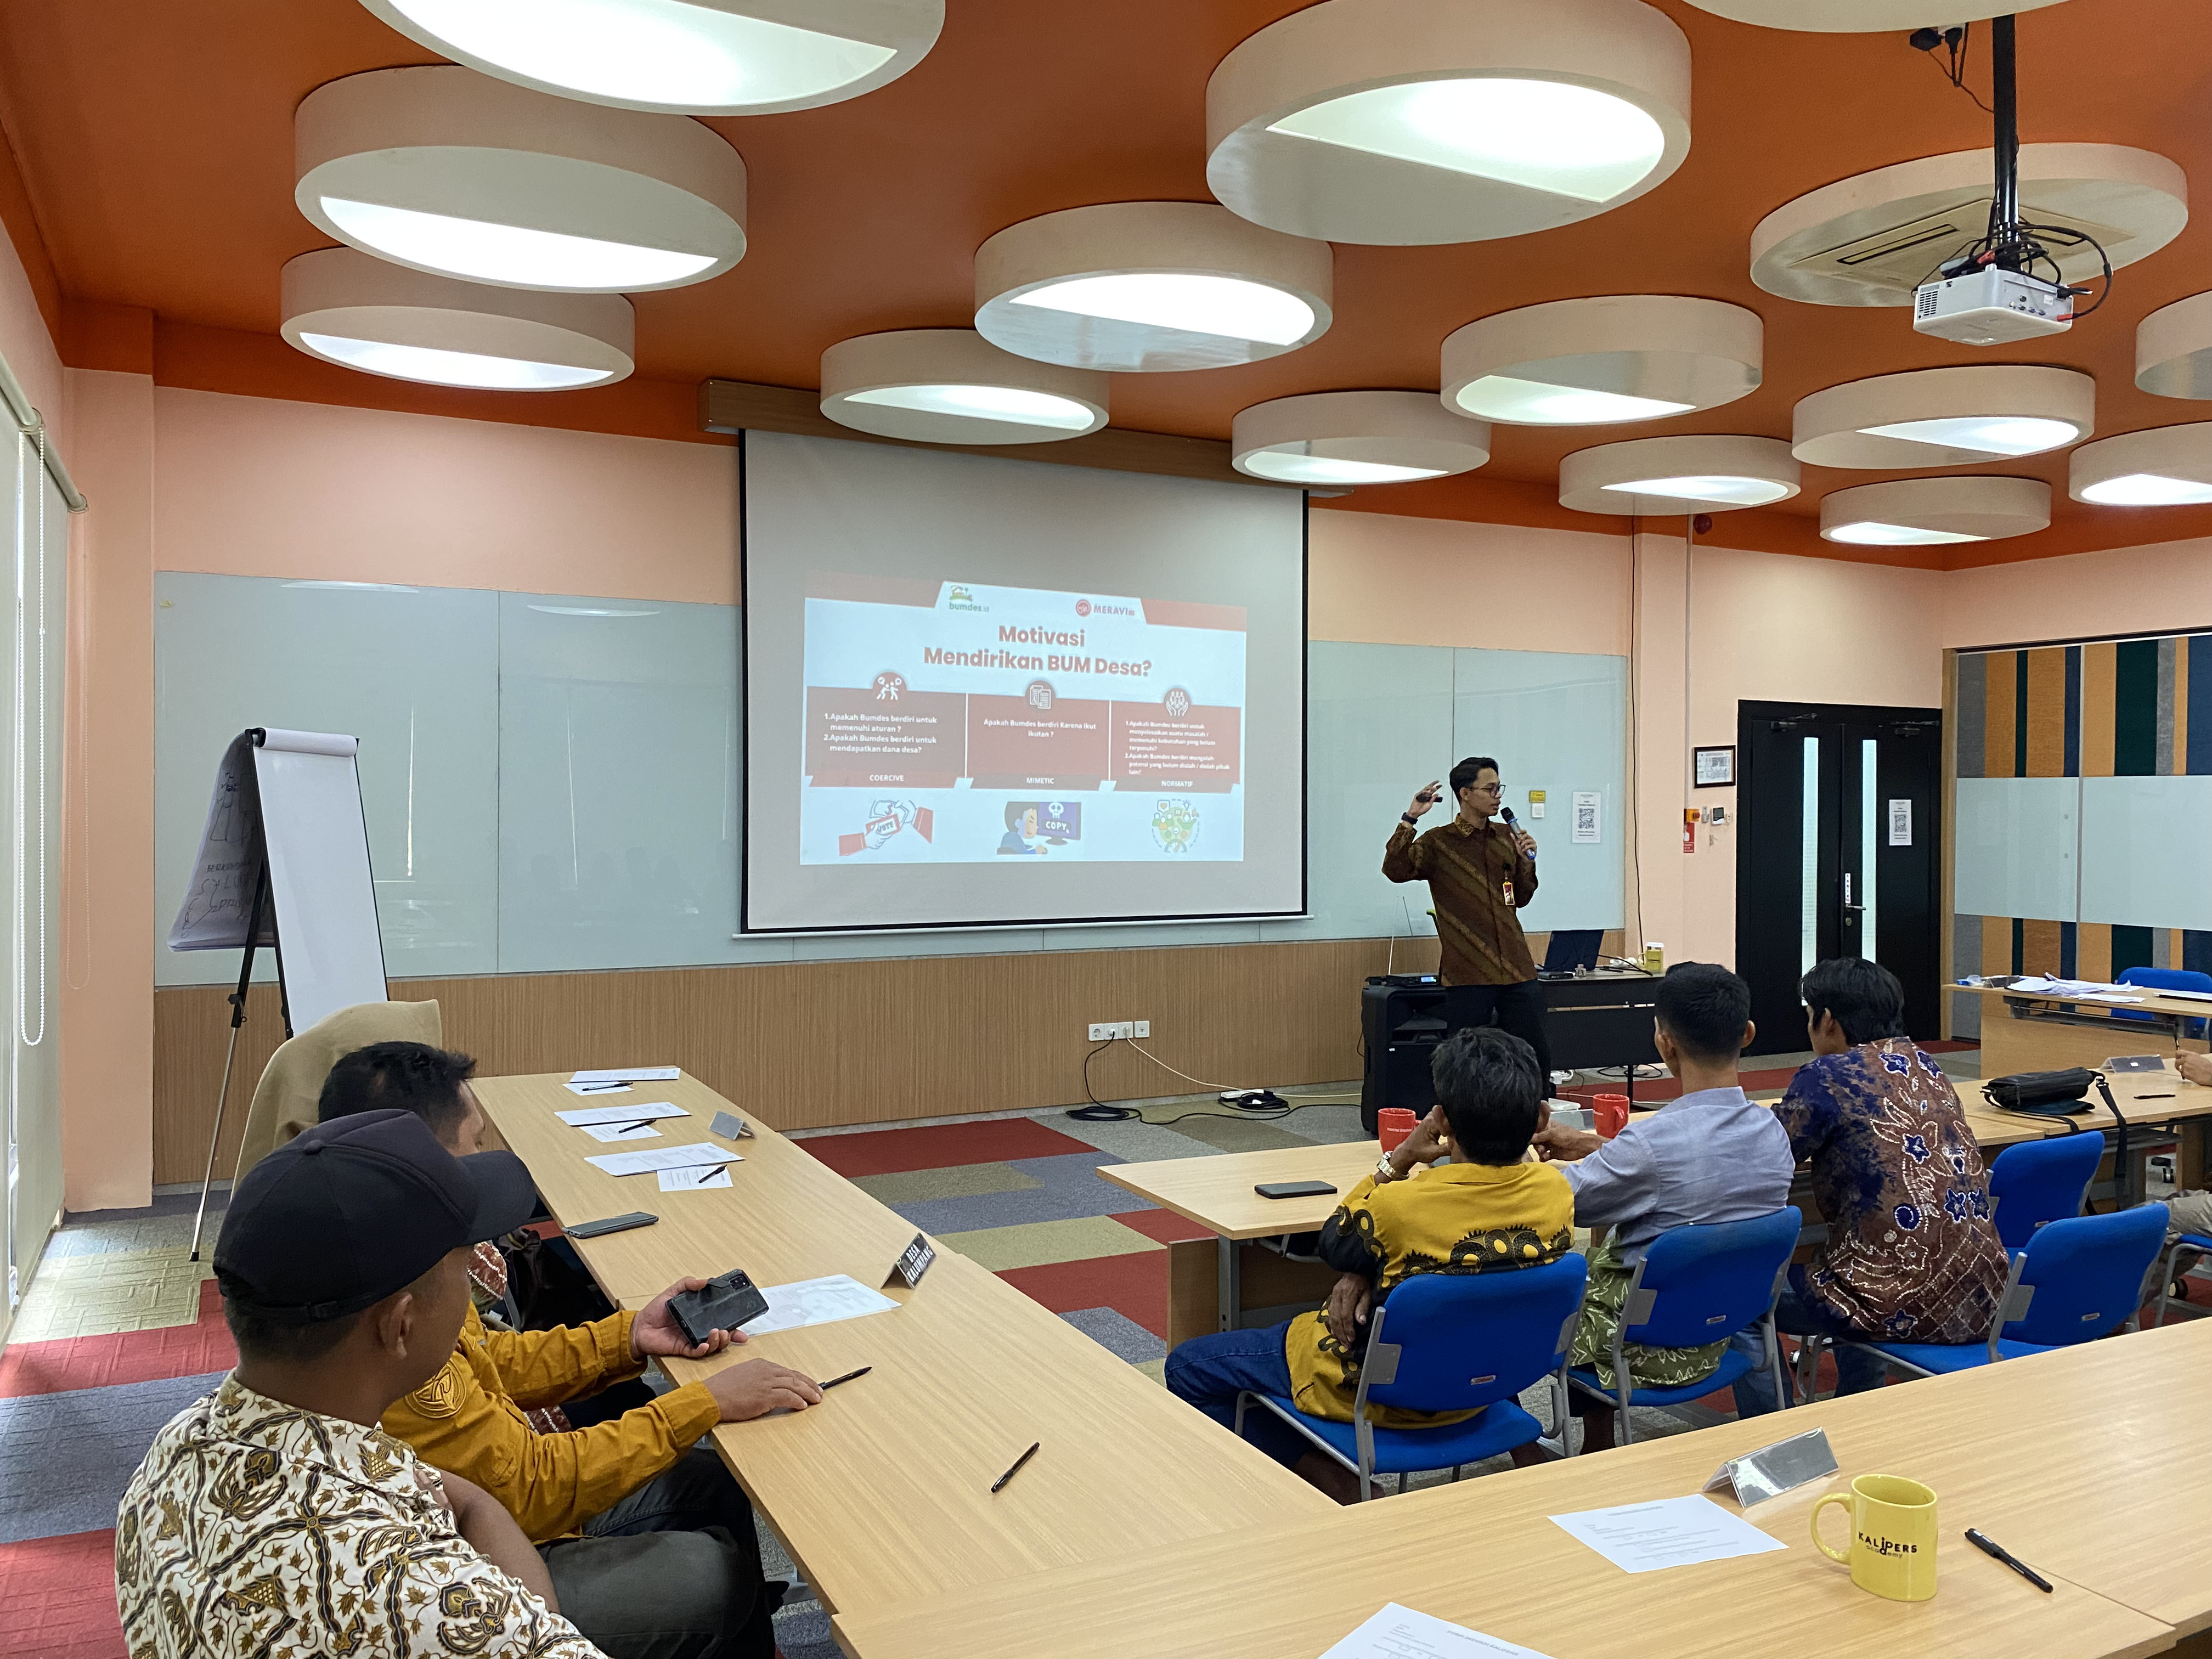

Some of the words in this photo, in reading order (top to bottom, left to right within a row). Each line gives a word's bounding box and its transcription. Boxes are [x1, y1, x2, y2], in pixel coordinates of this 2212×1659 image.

[998, 625, 1085, 647] Motivasi
[924, 646, 1043, 670] Mendirikan
[1047, 654, 1091, 673] BUM
[1094, 657, 1152, 677] Desa?
[860, 714, 889, 722] Bumdes
[890, 714, 915, 723] berdiri
[916, 715, 937, 724] untuk
[983, 719, 1009, 727] Apakah
[890, 735, 915, 743] berdiri
[830, 744, 881, 753] mendapatkan
[1046, 821, 1067, 831] COPY
[906, 1244, 921, 1263] DESA
[906, 1245, 933, 1283] KALUMPANG
